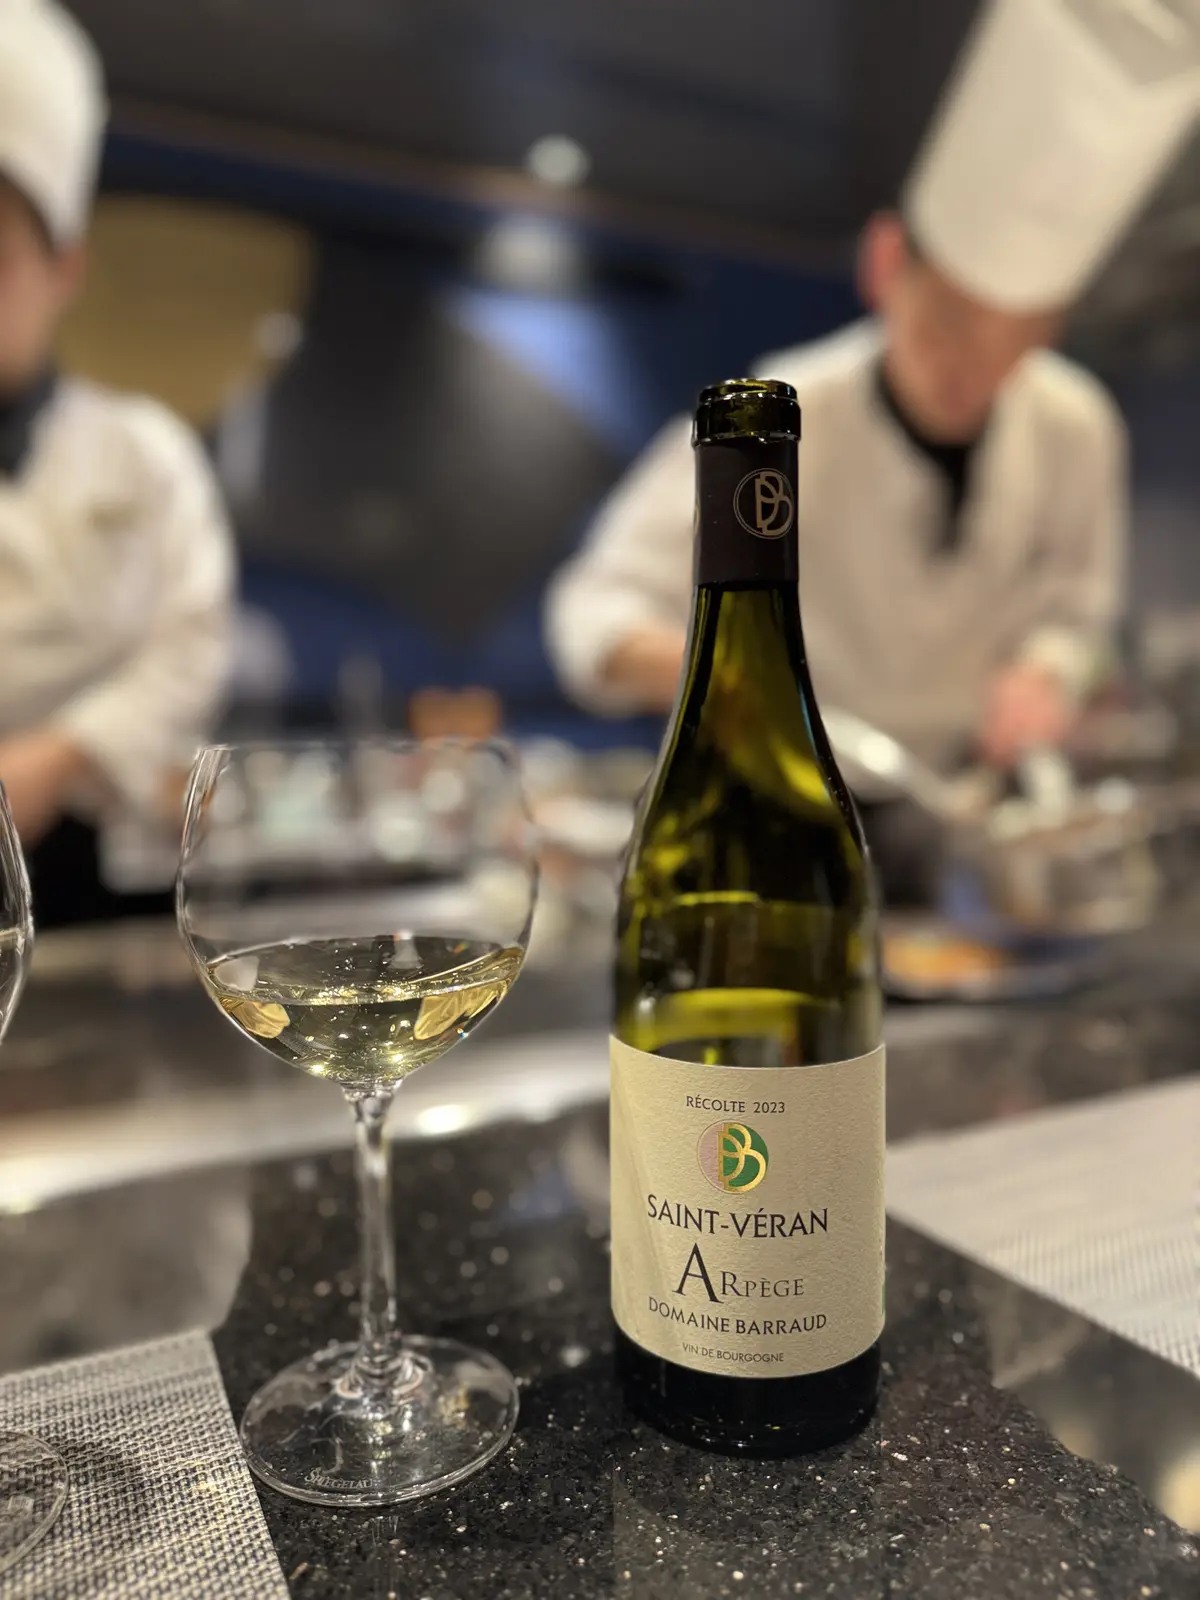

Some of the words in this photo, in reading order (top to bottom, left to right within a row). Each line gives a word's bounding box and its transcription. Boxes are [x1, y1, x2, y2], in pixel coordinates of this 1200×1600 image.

[686, 1095, 746, 1113] RÉCOLTE
[753, 1102, 786, 1114] 2023
[647, 1194, 828, 1238] SAINT-VÉRAN
[648, 1296, 730, 1333] DOMAINE
[735, 1313, 827, 1335] BARRAUD
[682, 1343, 699, 1354] VIN
[701, 1347, 714, 1358] DE
[716, 1350, 784, 1363] BOURGOGNE
